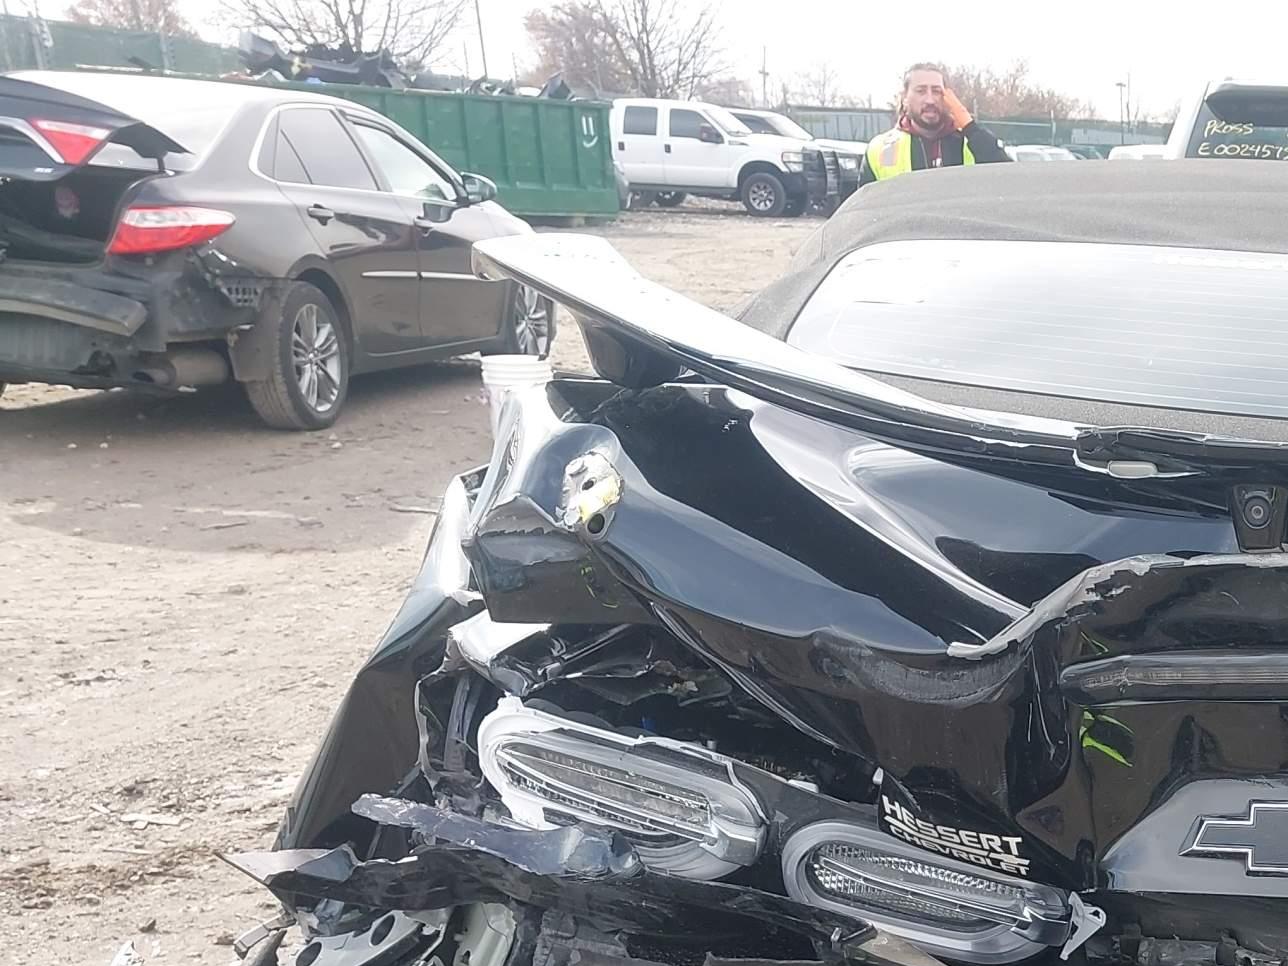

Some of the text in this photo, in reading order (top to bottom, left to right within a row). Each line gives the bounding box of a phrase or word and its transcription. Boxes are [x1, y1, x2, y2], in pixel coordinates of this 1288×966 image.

[1197, 142, 1211, 156] E
[881, 794, 1023, 856] HESSERT
[889, 824, 1030, 876] CHEVROLET
